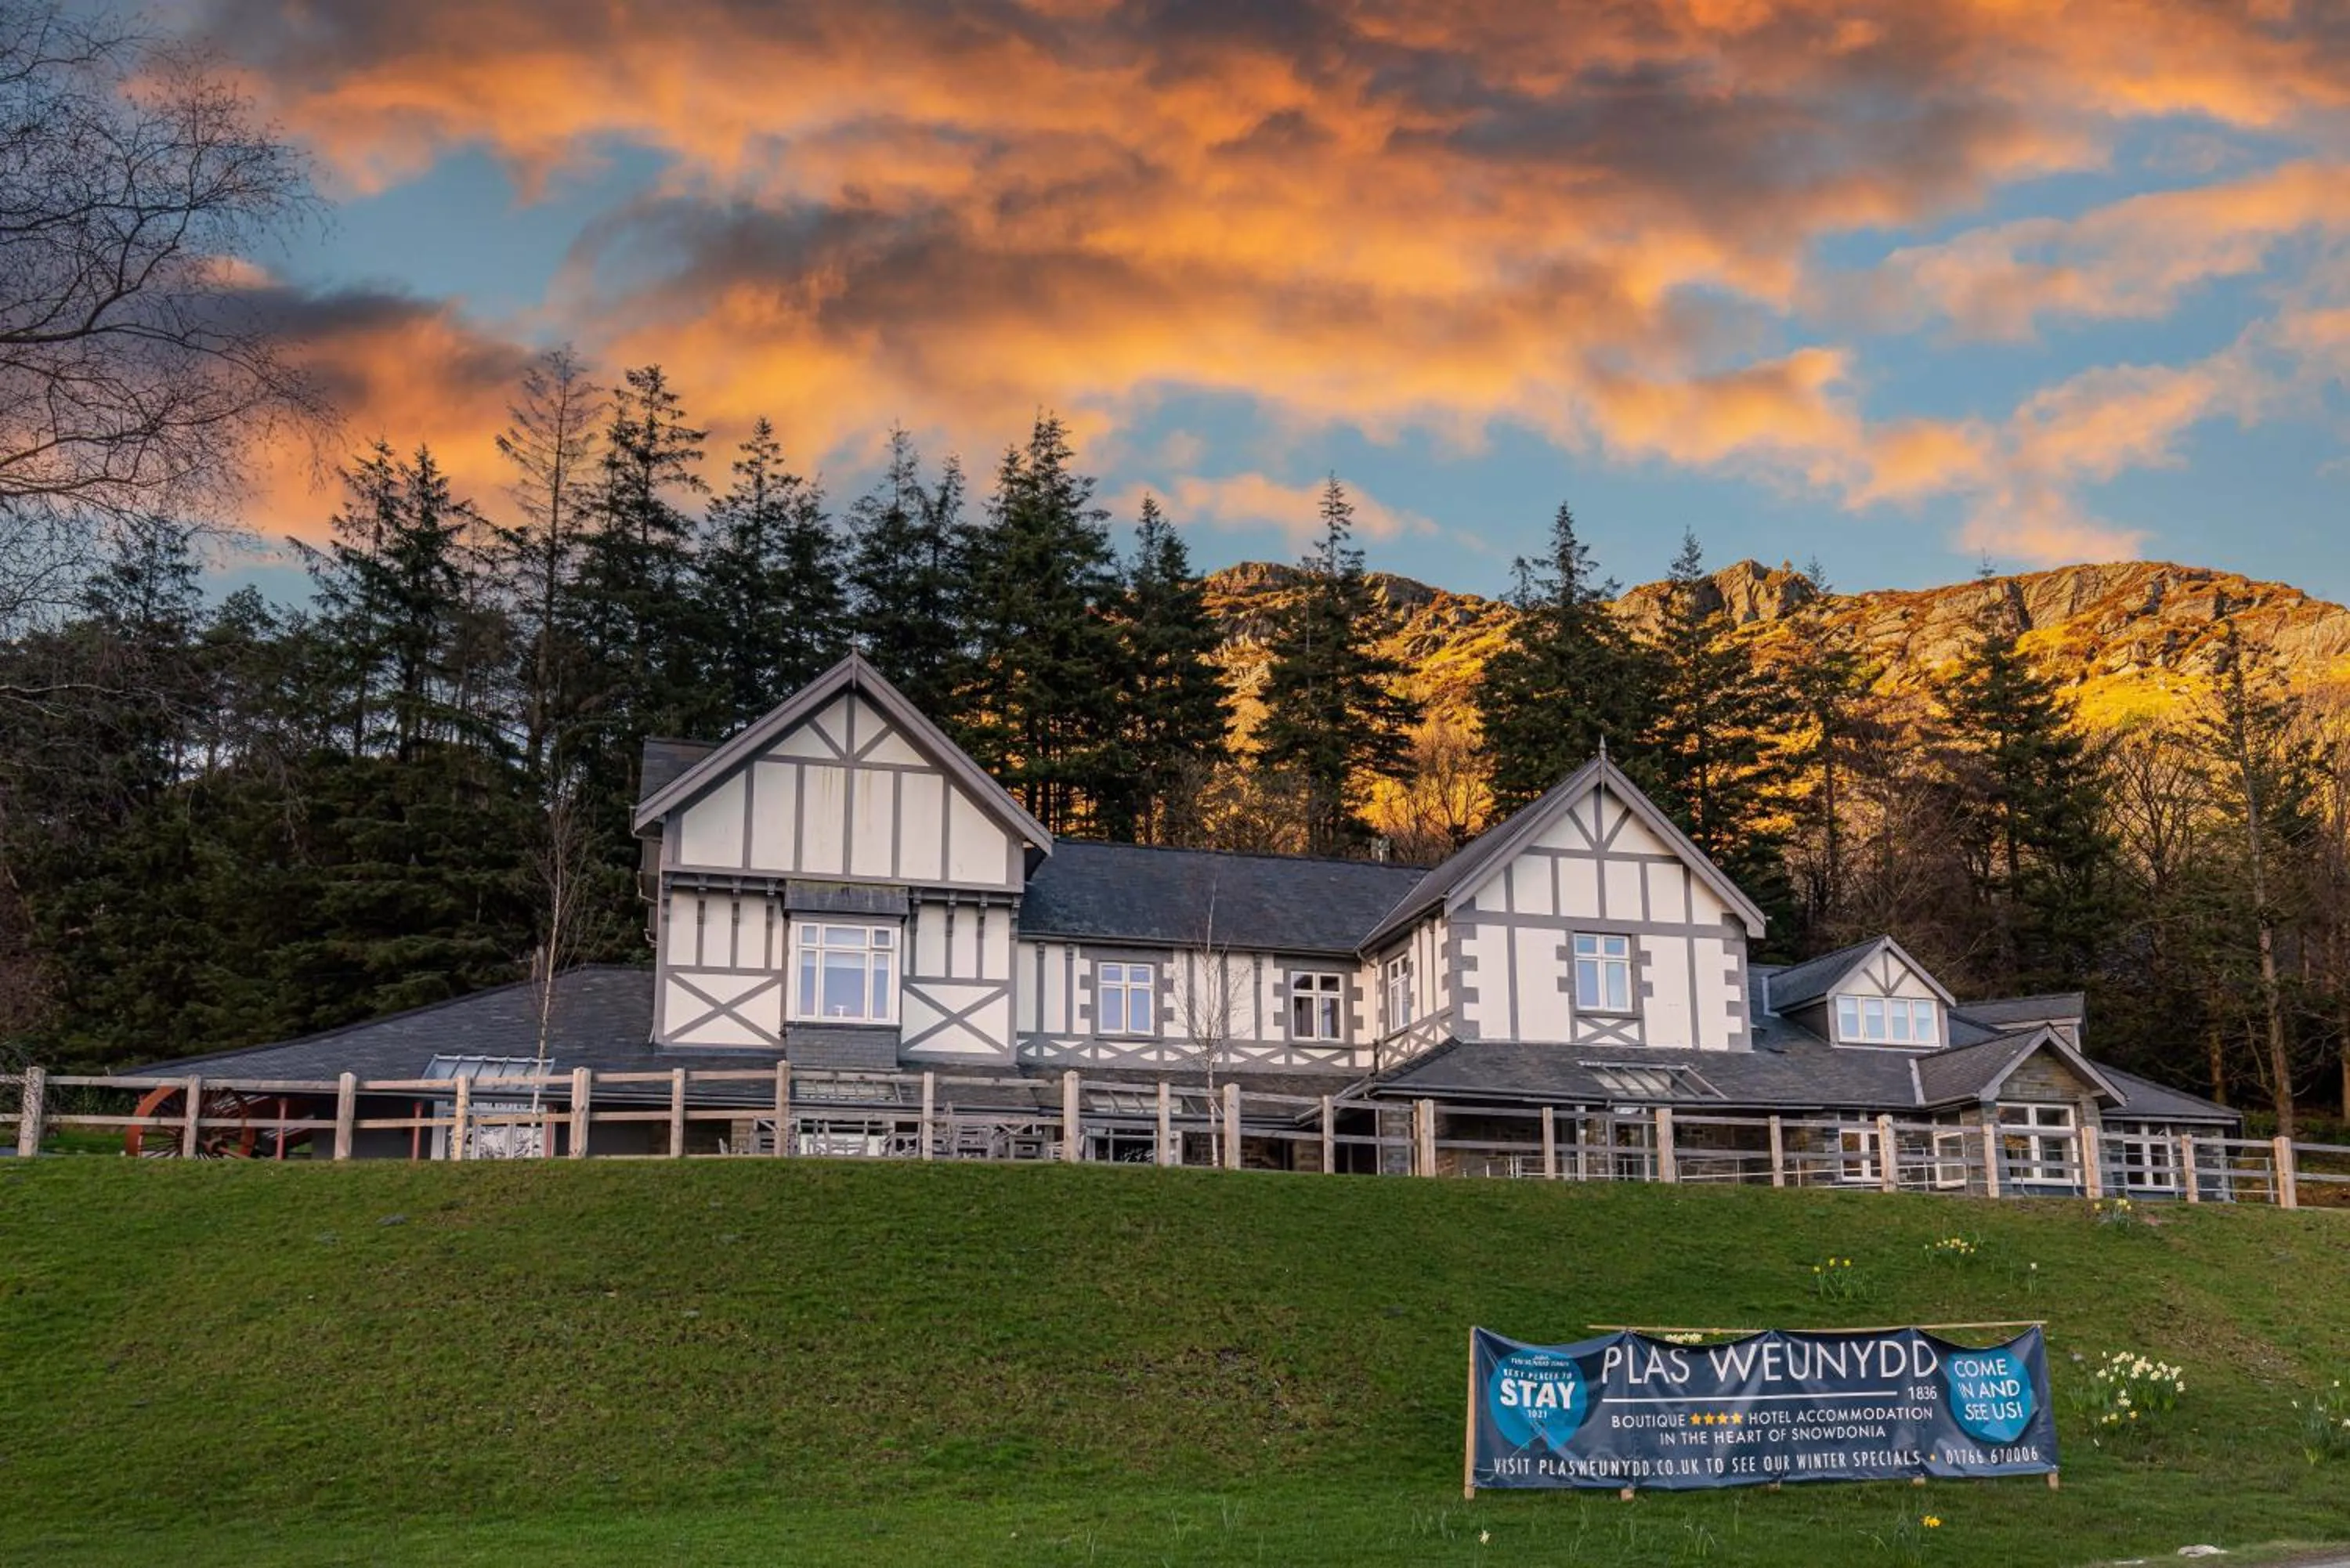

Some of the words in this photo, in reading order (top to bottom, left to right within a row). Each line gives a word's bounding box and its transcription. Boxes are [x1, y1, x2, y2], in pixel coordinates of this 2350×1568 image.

[1602, 1343, 1690, 1385] PLAS
[1708, 1340, 1938, 1382] WEUNYDD
[1954, 1358, 2008, 1378] COME
[1500, 1378, 1575, 1410] STAY
[1907, 1386, 1937, 1400] 1836
[1958, 1382, 1975, 1398] IN
[1979, 1379, 2020, 1398] AND
[1611, 1414, 1686, 1429] BOUTIQUE
[1748, 1411, 1791, 1425] HOTEL
[1796, 1407, 1933, 1422] ACCOMMODATION
[1965, 1403, 1990, 1421] SEE
[1991, 1401, 2023, 1420] US!
[1660, 1432, 1676, 1446] IN
[1681, 1431, 1708, 1445] THE
[1714, 1429, 1762, 1444] HEART
[1768, 1429, 1787, 1442] OF
[1791, 1425, 1886, 1440] SNOWDONIA
[1494, 1458, 1530, 1476] VISIT
[1538, 1458, 1700, 1477] PLASWEUNYDD.CO.UK
[1705, 1458, 1723, 1473] TO
[1732, 1456, 1755, 1473] SEE
[1763, 1454, 1790, 1472] OUR
[1796, 1451, 1847, 1470] WINTER
[1853, 1450, 1921, 1467] SPECIALS
